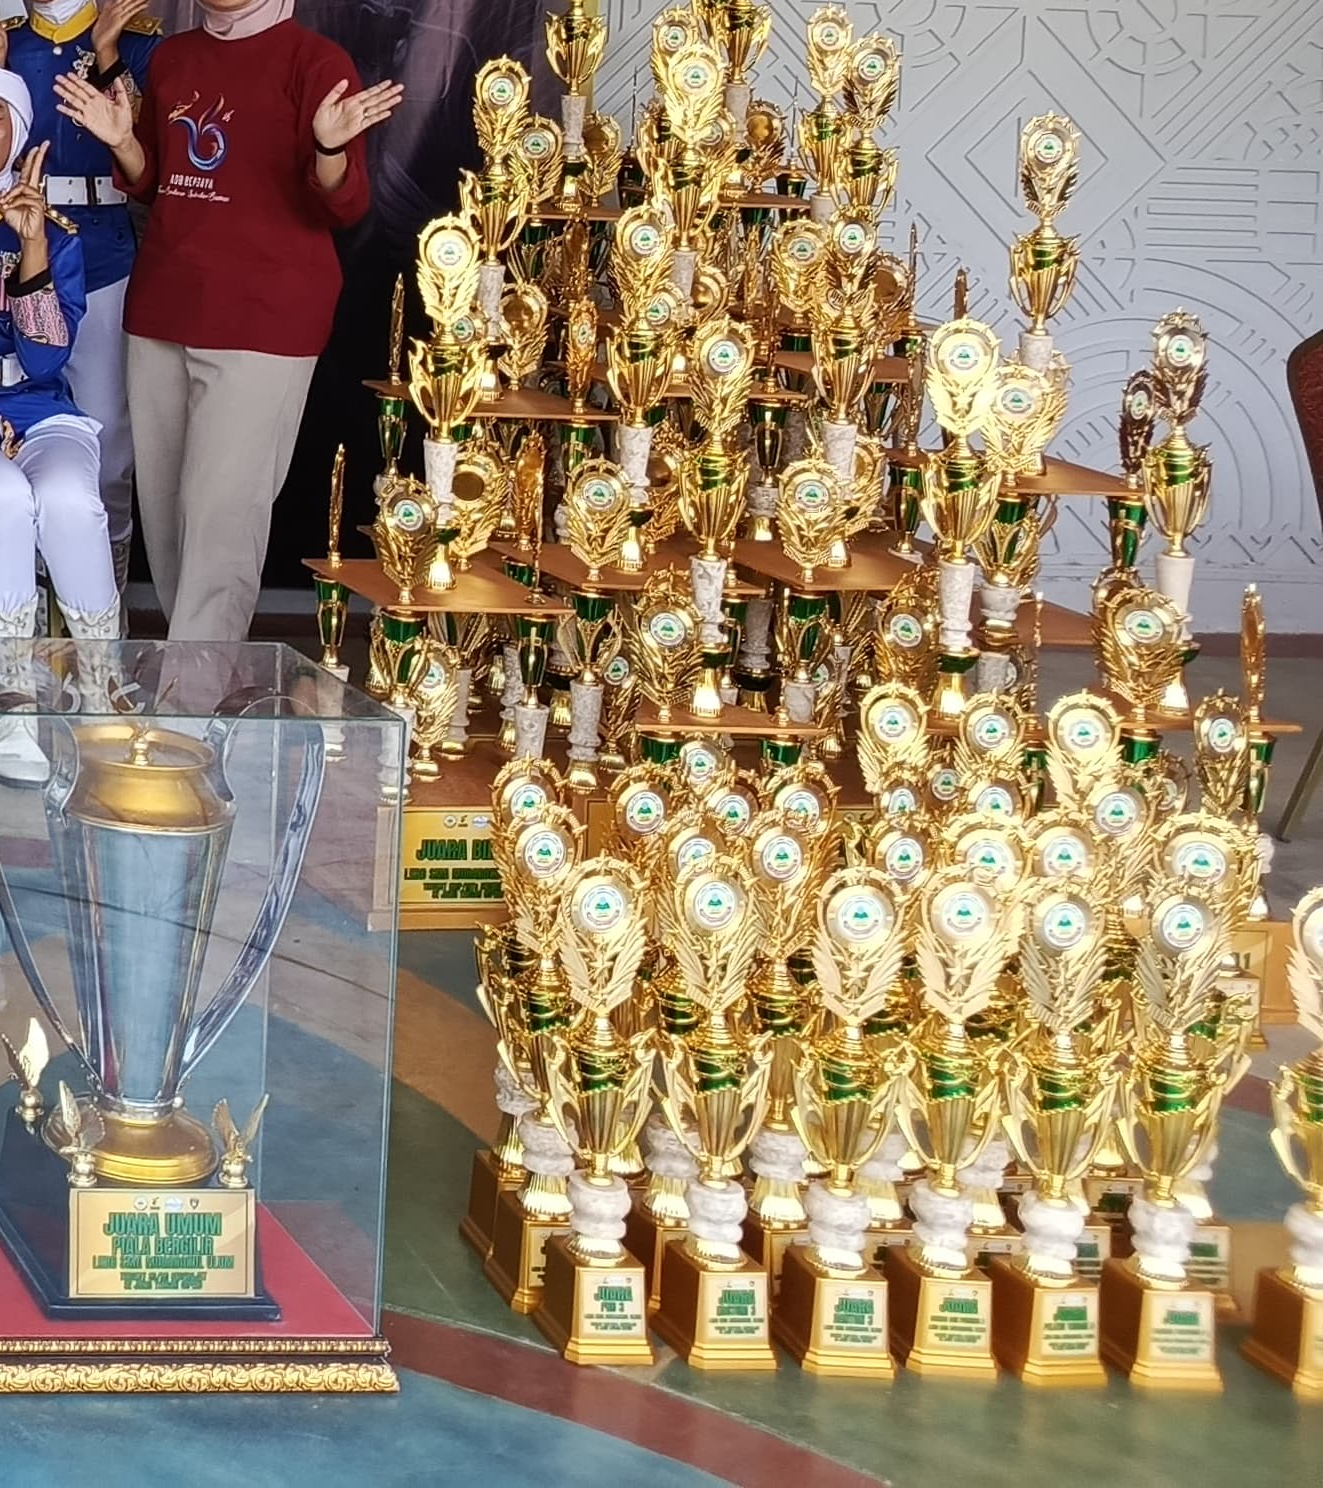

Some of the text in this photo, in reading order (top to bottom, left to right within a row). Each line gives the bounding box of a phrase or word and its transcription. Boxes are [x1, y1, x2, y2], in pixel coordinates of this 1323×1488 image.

[415, 838, 467, 861] JUARA
[103, 1212, 222, 1236] JUARA UMUM
[112, 1235, 214, 1255] PIALA BERGILIR
